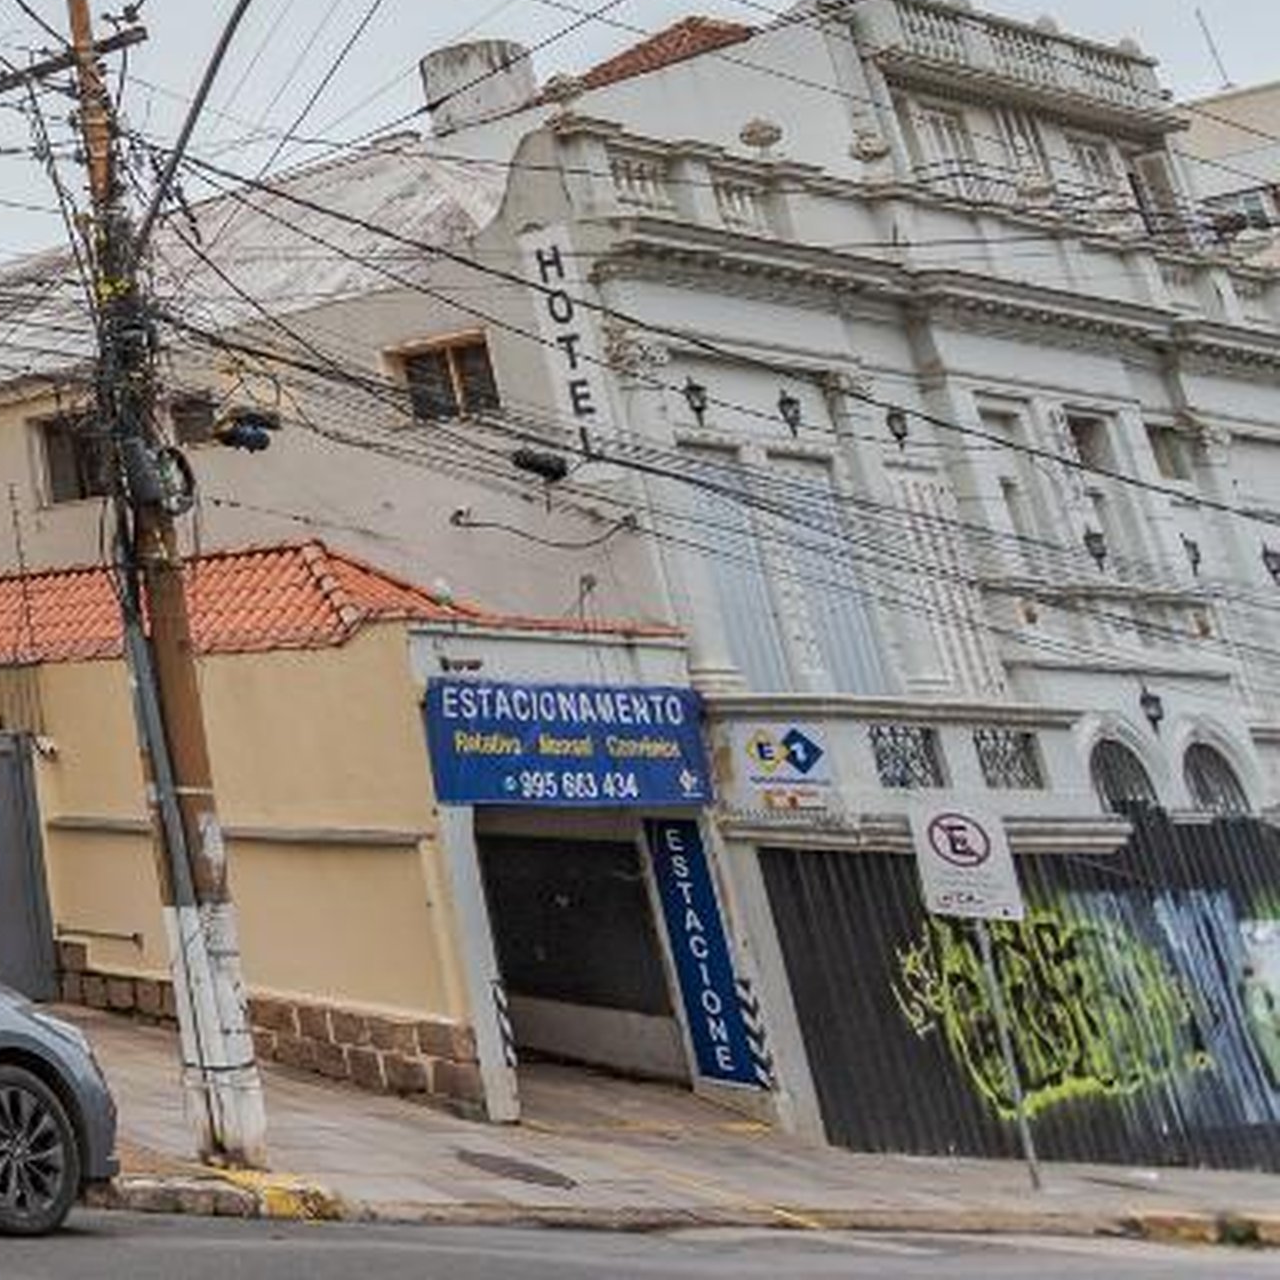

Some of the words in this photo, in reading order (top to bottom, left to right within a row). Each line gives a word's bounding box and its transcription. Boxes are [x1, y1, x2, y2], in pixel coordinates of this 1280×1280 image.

[536, 245, 596, 457] HOTEL
[442, 687, 682, 724] ESTACIONAMENTO
[665, 828, 735, 1071] ESTACIONE
